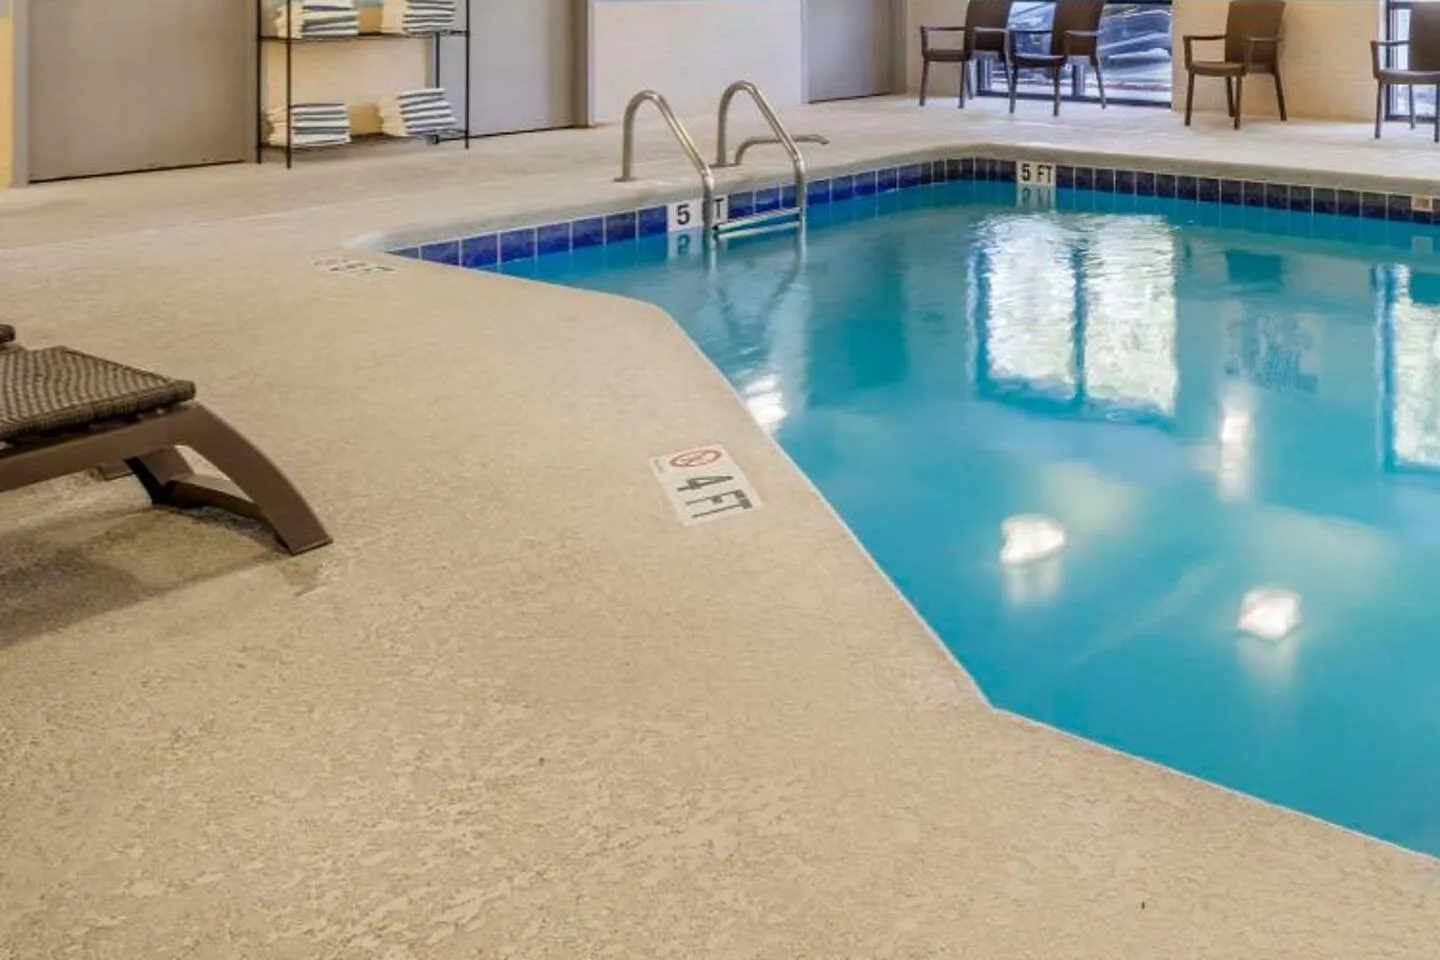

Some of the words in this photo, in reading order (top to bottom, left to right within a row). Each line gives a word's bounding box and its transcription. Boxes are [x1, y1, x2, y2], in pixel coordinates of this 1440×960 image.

[1022, 163, 1031, 181] 5
[1037, 164, 1052, 184] FT
[677, 203, 691, 225] 5
[676, 476, 734, 491] 4
[685, 489, 752, 518] FT
